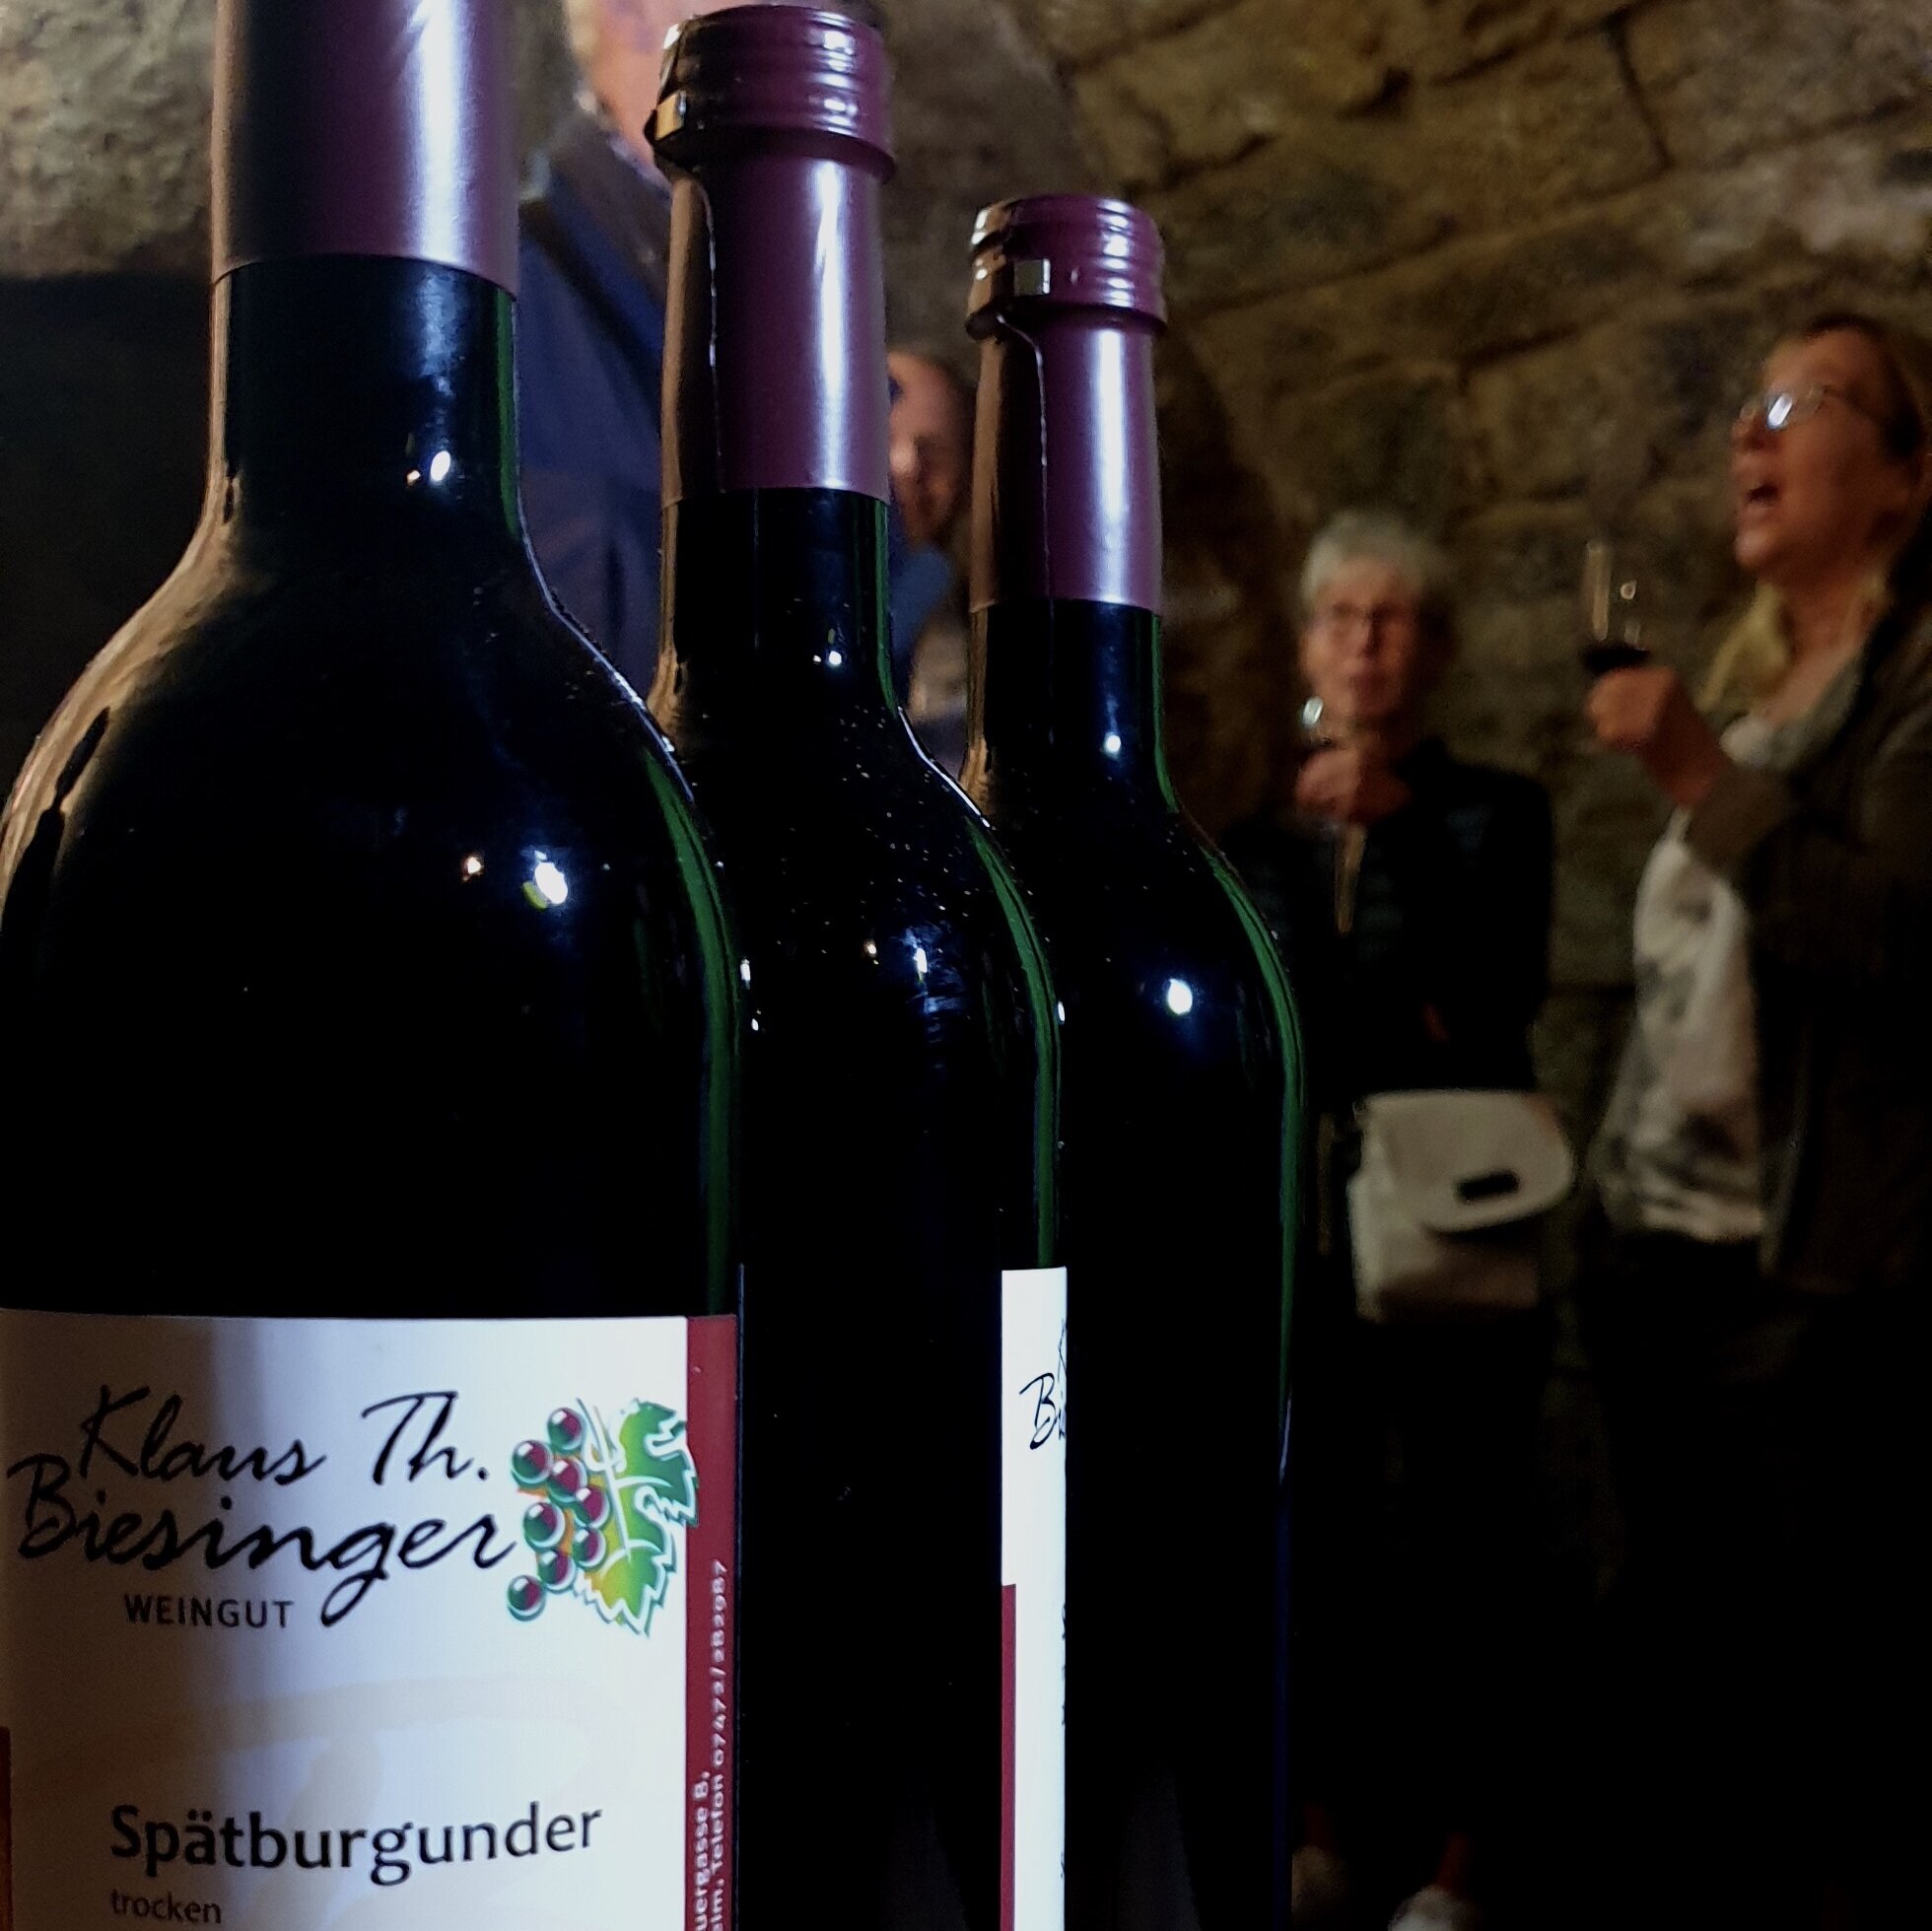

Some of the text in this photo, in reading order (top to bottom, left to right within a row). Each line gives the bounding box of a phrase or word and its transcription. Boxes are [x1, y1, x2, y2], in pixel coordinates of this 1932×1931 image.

[78, 1383, 491, 1487] Klaus Th.
[5, 1452, 518, 1628] Biesinger
[123, 1593, 295, 1629] WEINGUT
[110, 1800, 603, 1891] Spätburgunder
[710, 1773, 724, 1876] Telefon
[108, 1887, 223, 1925] trocken
